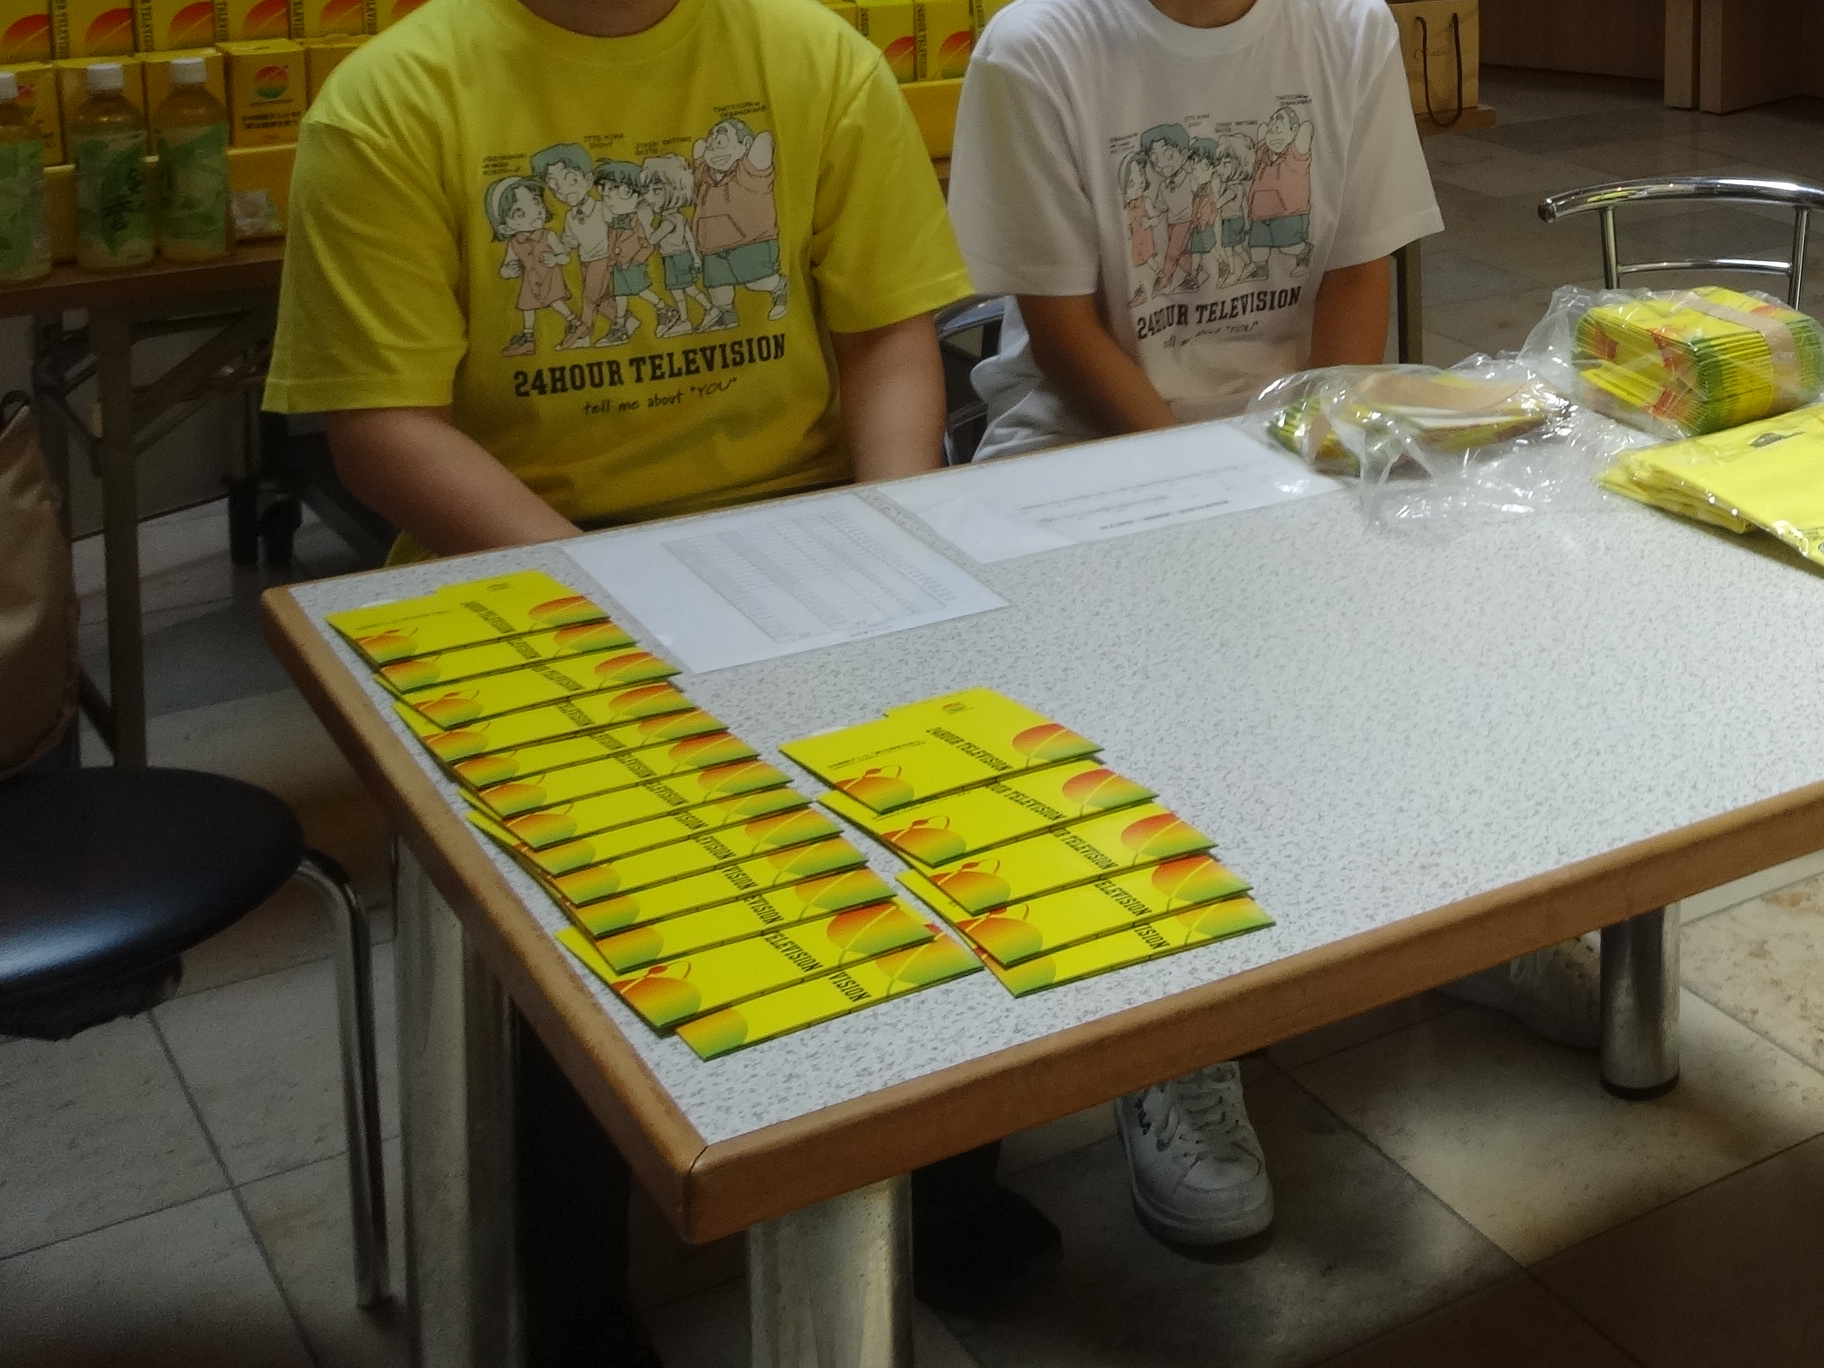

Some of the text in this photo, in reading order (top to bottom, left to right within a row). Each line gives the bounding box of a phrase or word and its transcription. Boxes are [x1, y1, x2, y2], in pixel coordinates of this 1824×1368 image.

[1195, 286, 1302, 325] TELEVISION
[514, 333, 786, 398] 24HOUR TELEVISION
[583, 399, 611, 416] tell
[618, 399, 640, 412] me
[648, 391, 685, 408] about
